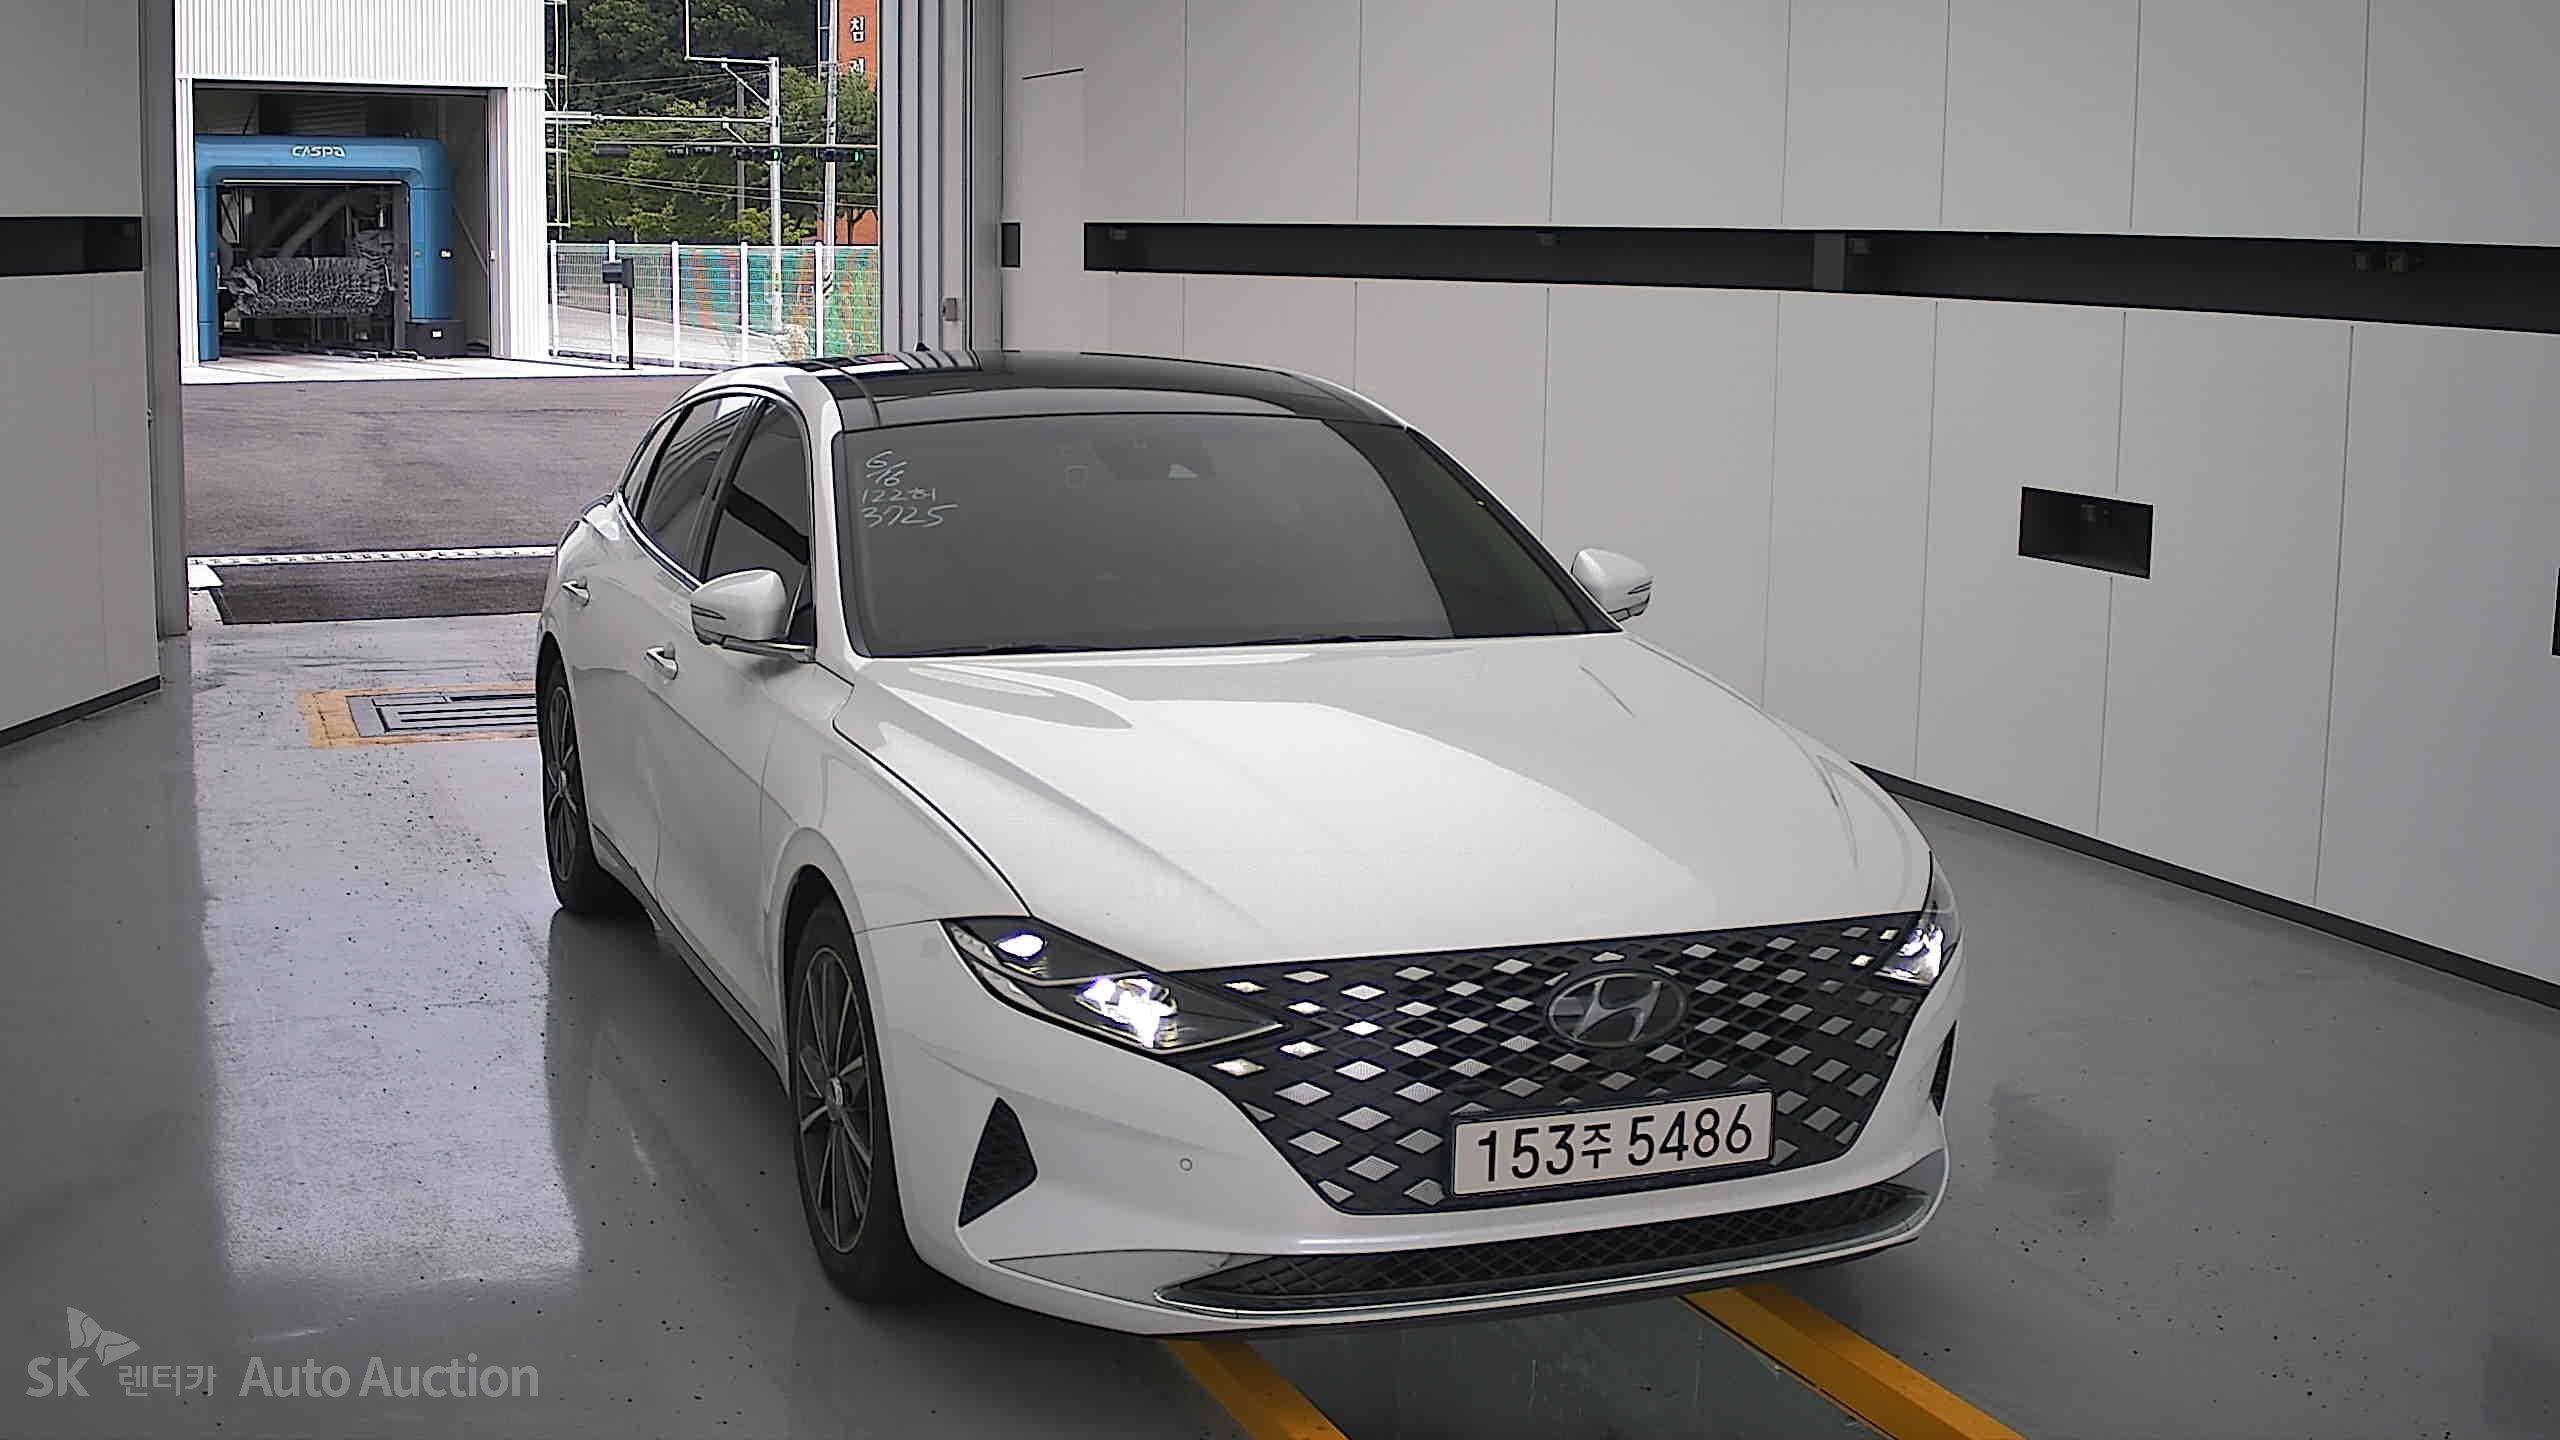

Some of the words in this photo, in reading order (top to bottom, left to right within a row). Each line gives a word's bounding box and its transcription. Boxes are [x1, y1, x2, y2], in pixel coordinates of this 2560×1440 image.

[861, 504, 959, 528] 3725
[1477, 1122, 1612, 1183] 153주
[1627, 1103, 1753, 1167] 5486
